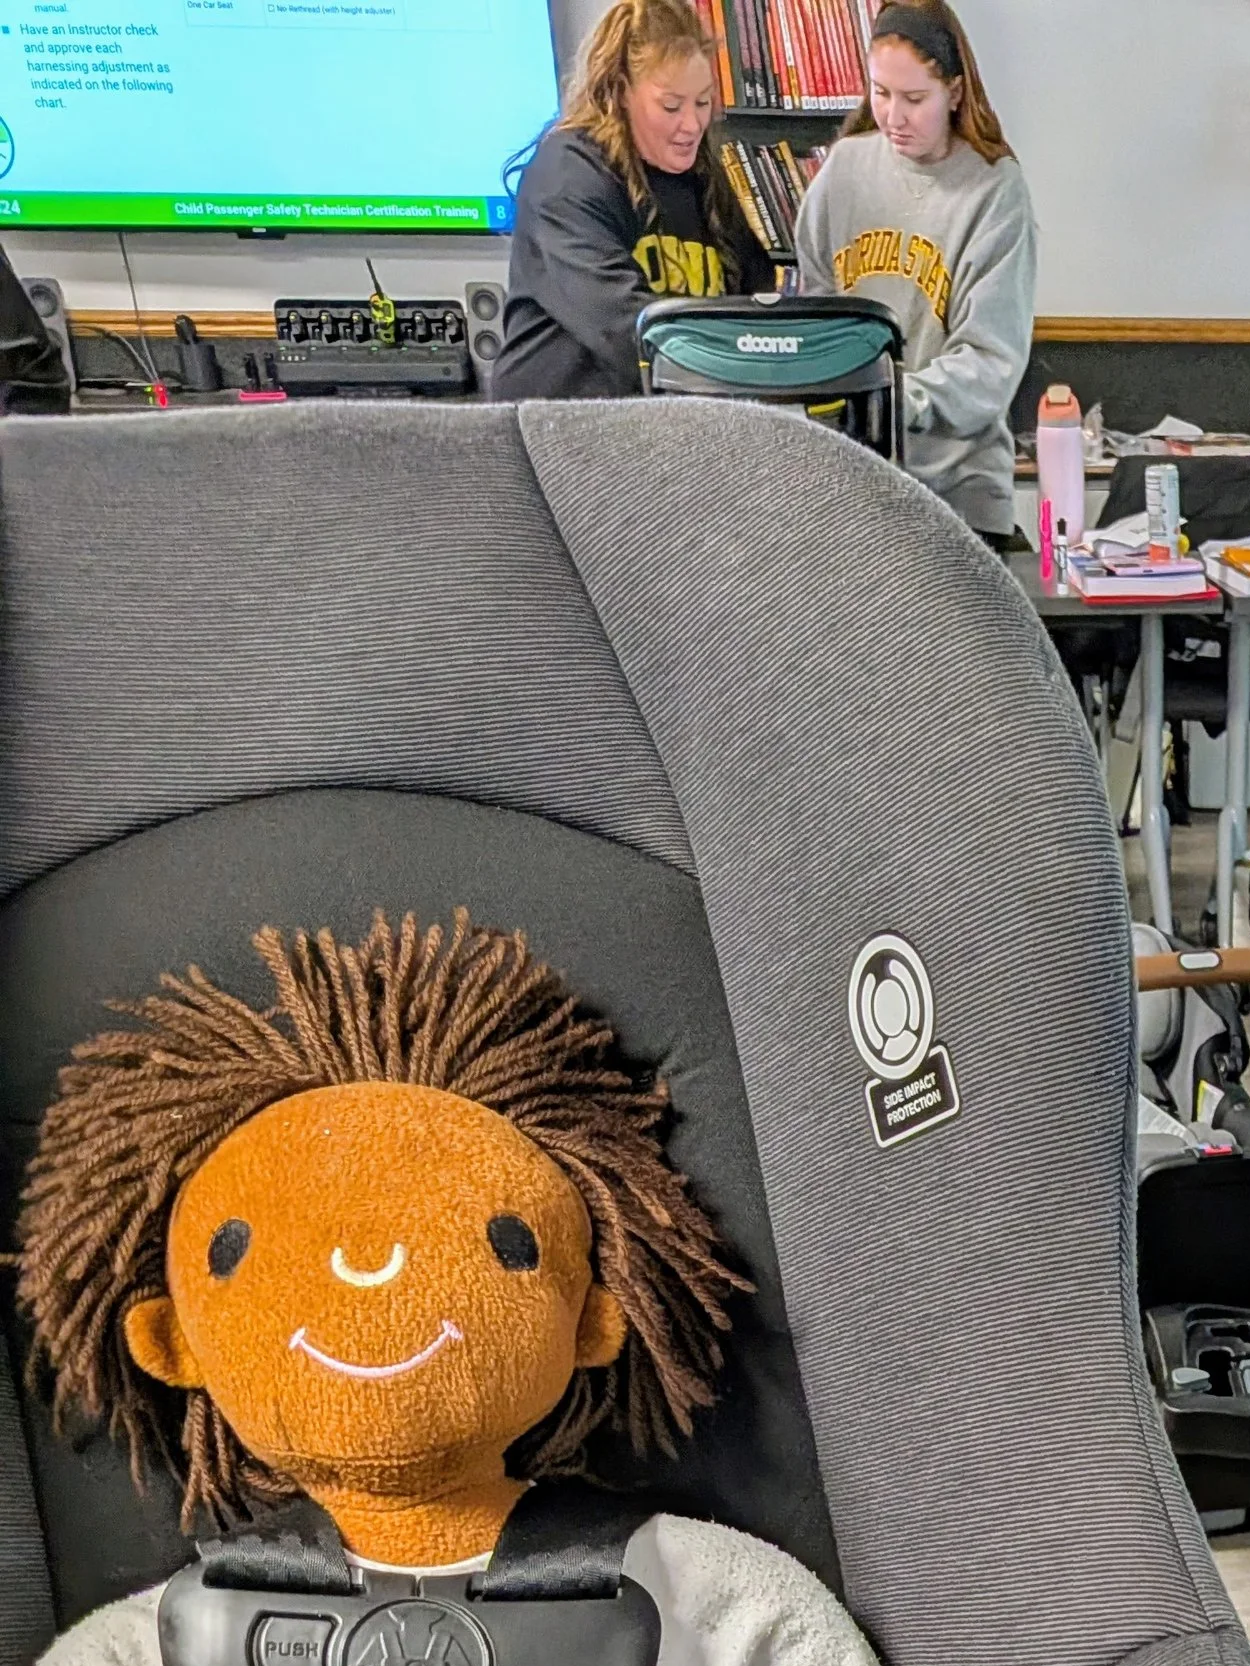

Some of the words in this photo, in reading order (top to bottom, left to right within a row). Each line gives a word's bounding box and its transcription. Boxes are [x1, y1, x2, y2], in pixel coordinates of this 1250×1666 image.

[35, 3, 68, 13] manual.
[20, 24, 48, 35] Have
[52, 26, 65, 35] an
[68, 24, 122, 35] Instructor
[126, 24, 158, 35] check
[24, 42, 44, 53] and
[48, 44, 92, 55] approve
[96, 42, 122, 53] each
[27, 60, 89, 74] harnessing
[92, 60, 154, 74] adjustment
[157, 64, 170, 73] as
[31, 78, 82, 90] indicated
[86, 81, 99, 90] on
[102, 79, 120, 90] the
[122, 79, 173, 93] following
[35, 97, 67, 108] chart.
[174, 202, 202, 215] Child
[205, 203, 264, 217] Passenger
[267, 203, 301, 217] Safety
[304, 204, 363, 217] Technician
[365, 204, 431, 218] Certification
[434, 205, 479, 219] Training
[496, 205, 506, 219] 8
[736, 333, 798, 353] doona
[883, 1088, 905, 1110] SIDE
[903, 1071, 937, 1098] IMPACT
[886, 1089, 942, 1127] PROTECTION
[265, 1641, 319, 1659] PUSH
